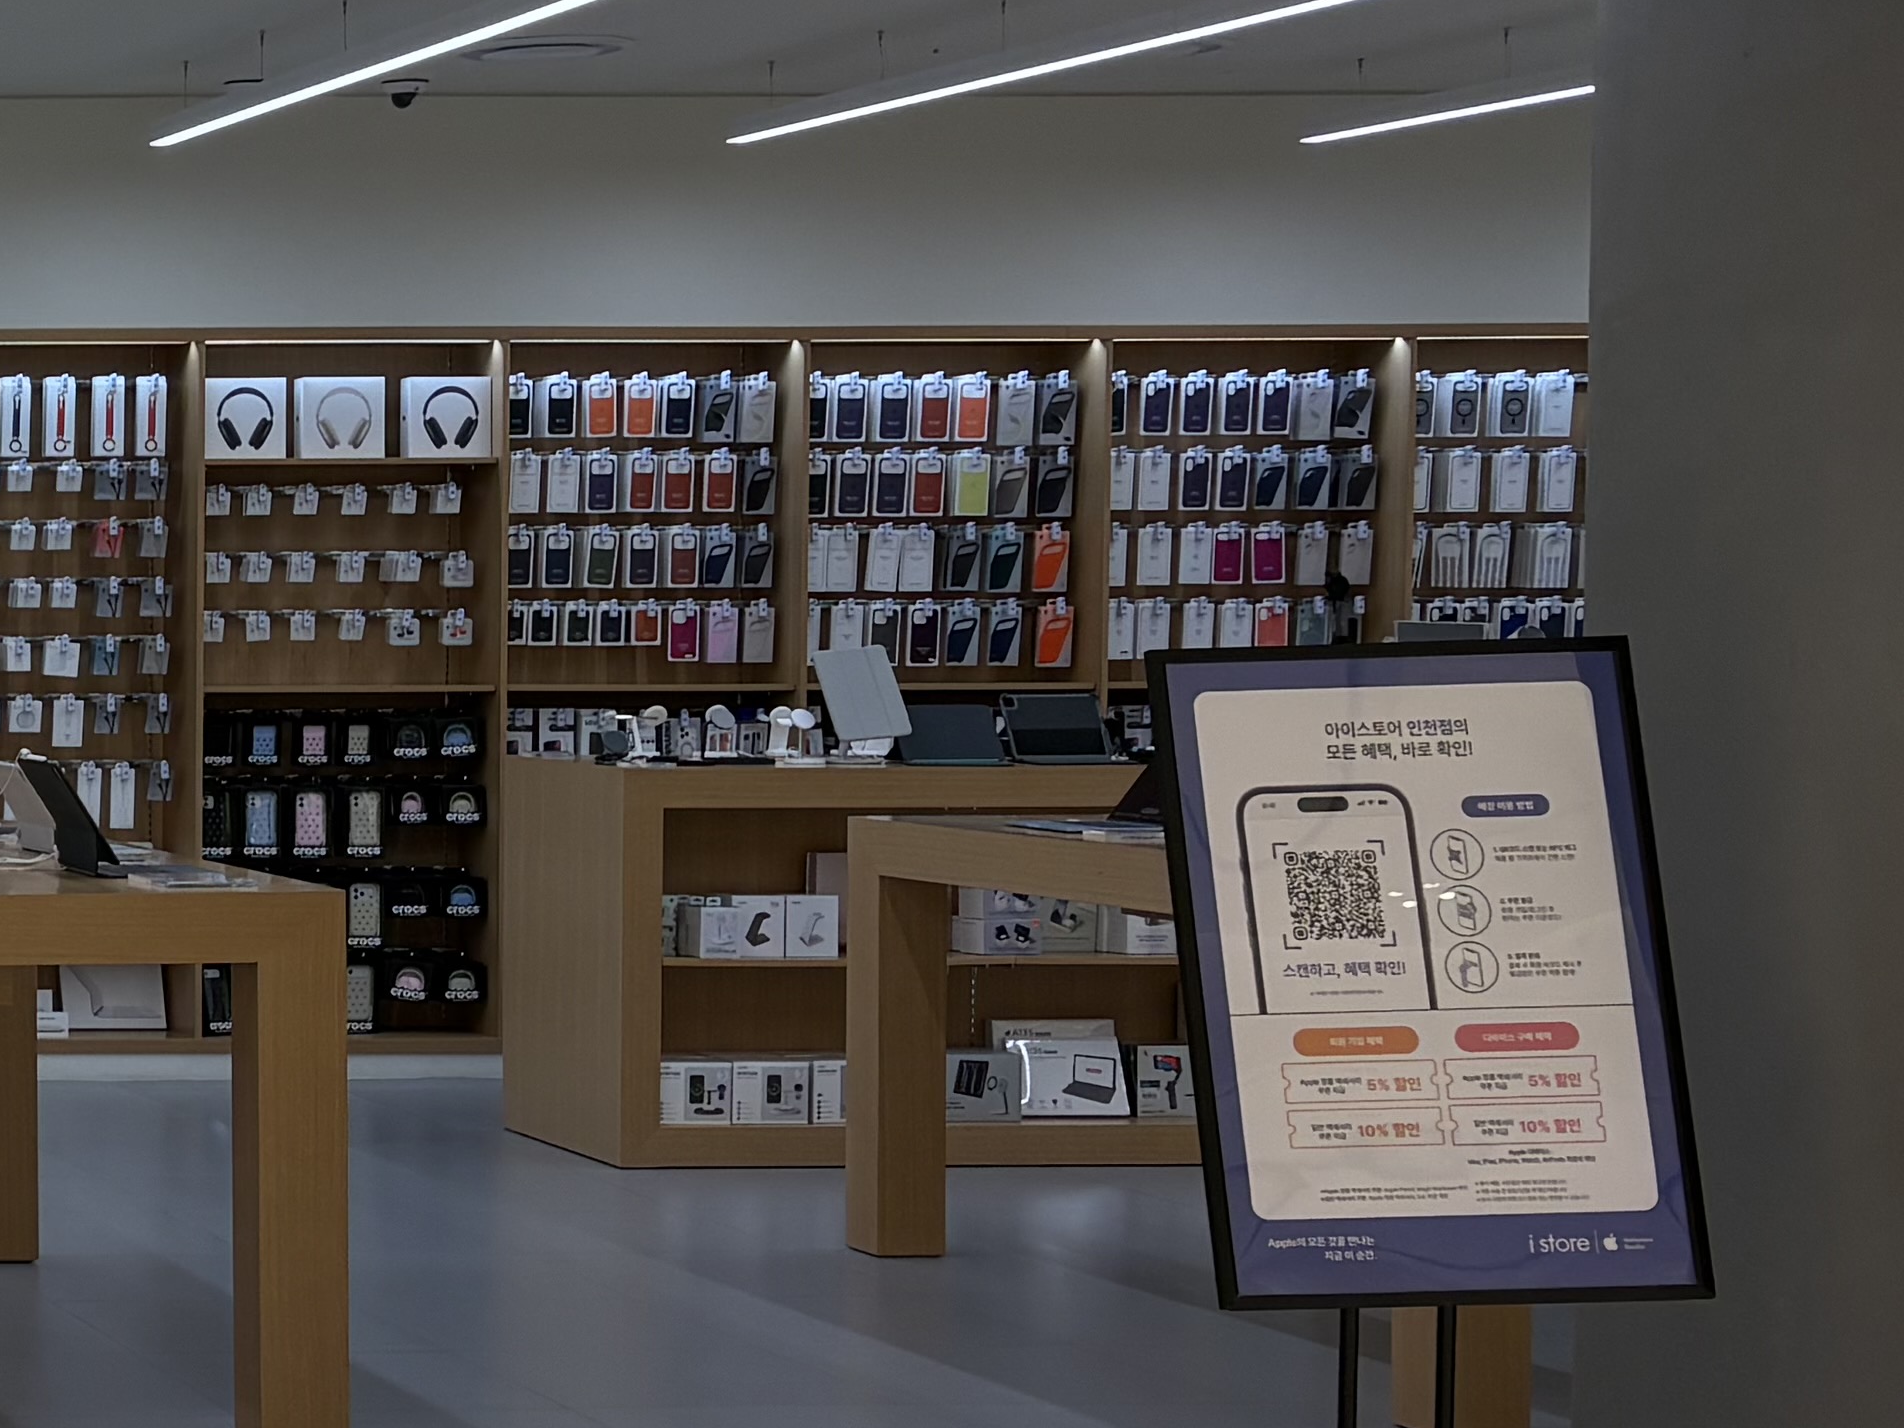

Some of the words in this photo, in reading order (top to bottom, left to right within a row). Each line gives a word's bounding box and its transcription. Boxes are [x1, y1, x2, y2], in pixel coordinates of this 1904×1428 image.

[1325, 720, 1402, 739] 아이스토어
[1406, 718, 1469, 737] 인천점의
[1326, 743, 1357, 760] 모든
[1361, 742, 1397, 761] 혜택,
[1401, 741, 1433, 758] 바로
[1437, 740, 1473, 757] 확인!
[1374, 961, 1406, 975] 확인!
[1366, 1078, 1390, 1092] 5%
[1393, 1077, 1422, 1092] 할인
[1528, 1074, 1551, 1088] 5%
[1554, 1072, 1581, 1088] 할인
[1358, 1124, 1389, 1138] 10%
[1392, 1122, 1420, 1138] 할인
[1519, 1120, 1550, 1134] 10%
[1553, 1118, 1581, 1134] 할인
[1529, 1234, 1534, 1253] i
[1539, 1233, 1590, 1253] store
